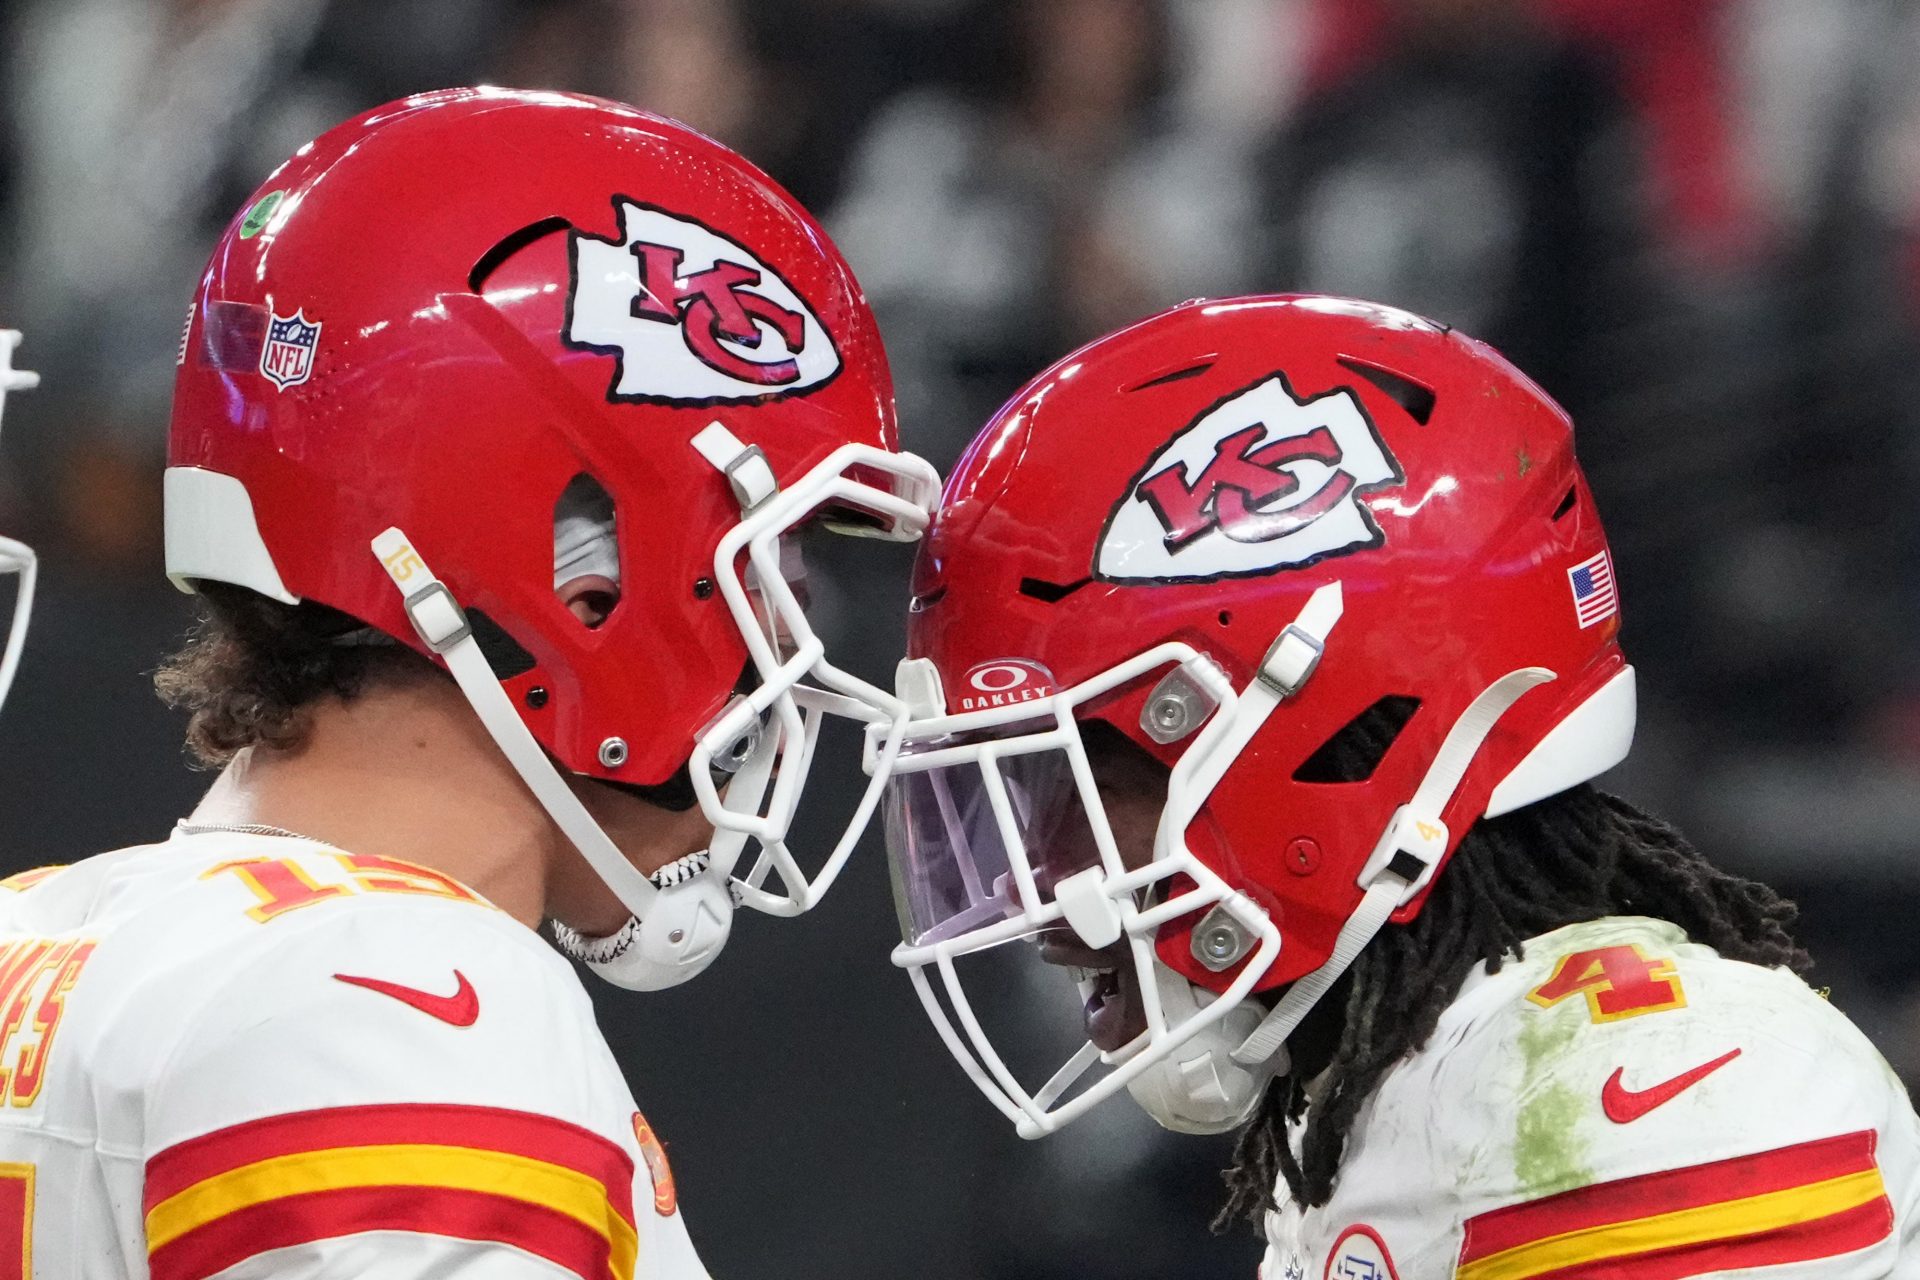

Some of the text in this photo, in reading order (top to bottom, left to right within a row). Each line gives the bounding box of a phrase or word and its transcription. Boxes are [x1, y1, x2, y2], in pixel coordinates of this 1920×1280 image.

[268, 343, 304, 378] NFL
[384, 544, 424, 582] 15
[962, 686, 1049, 710] OAKLEY
[1526, 944, 1688, 1024] 4
